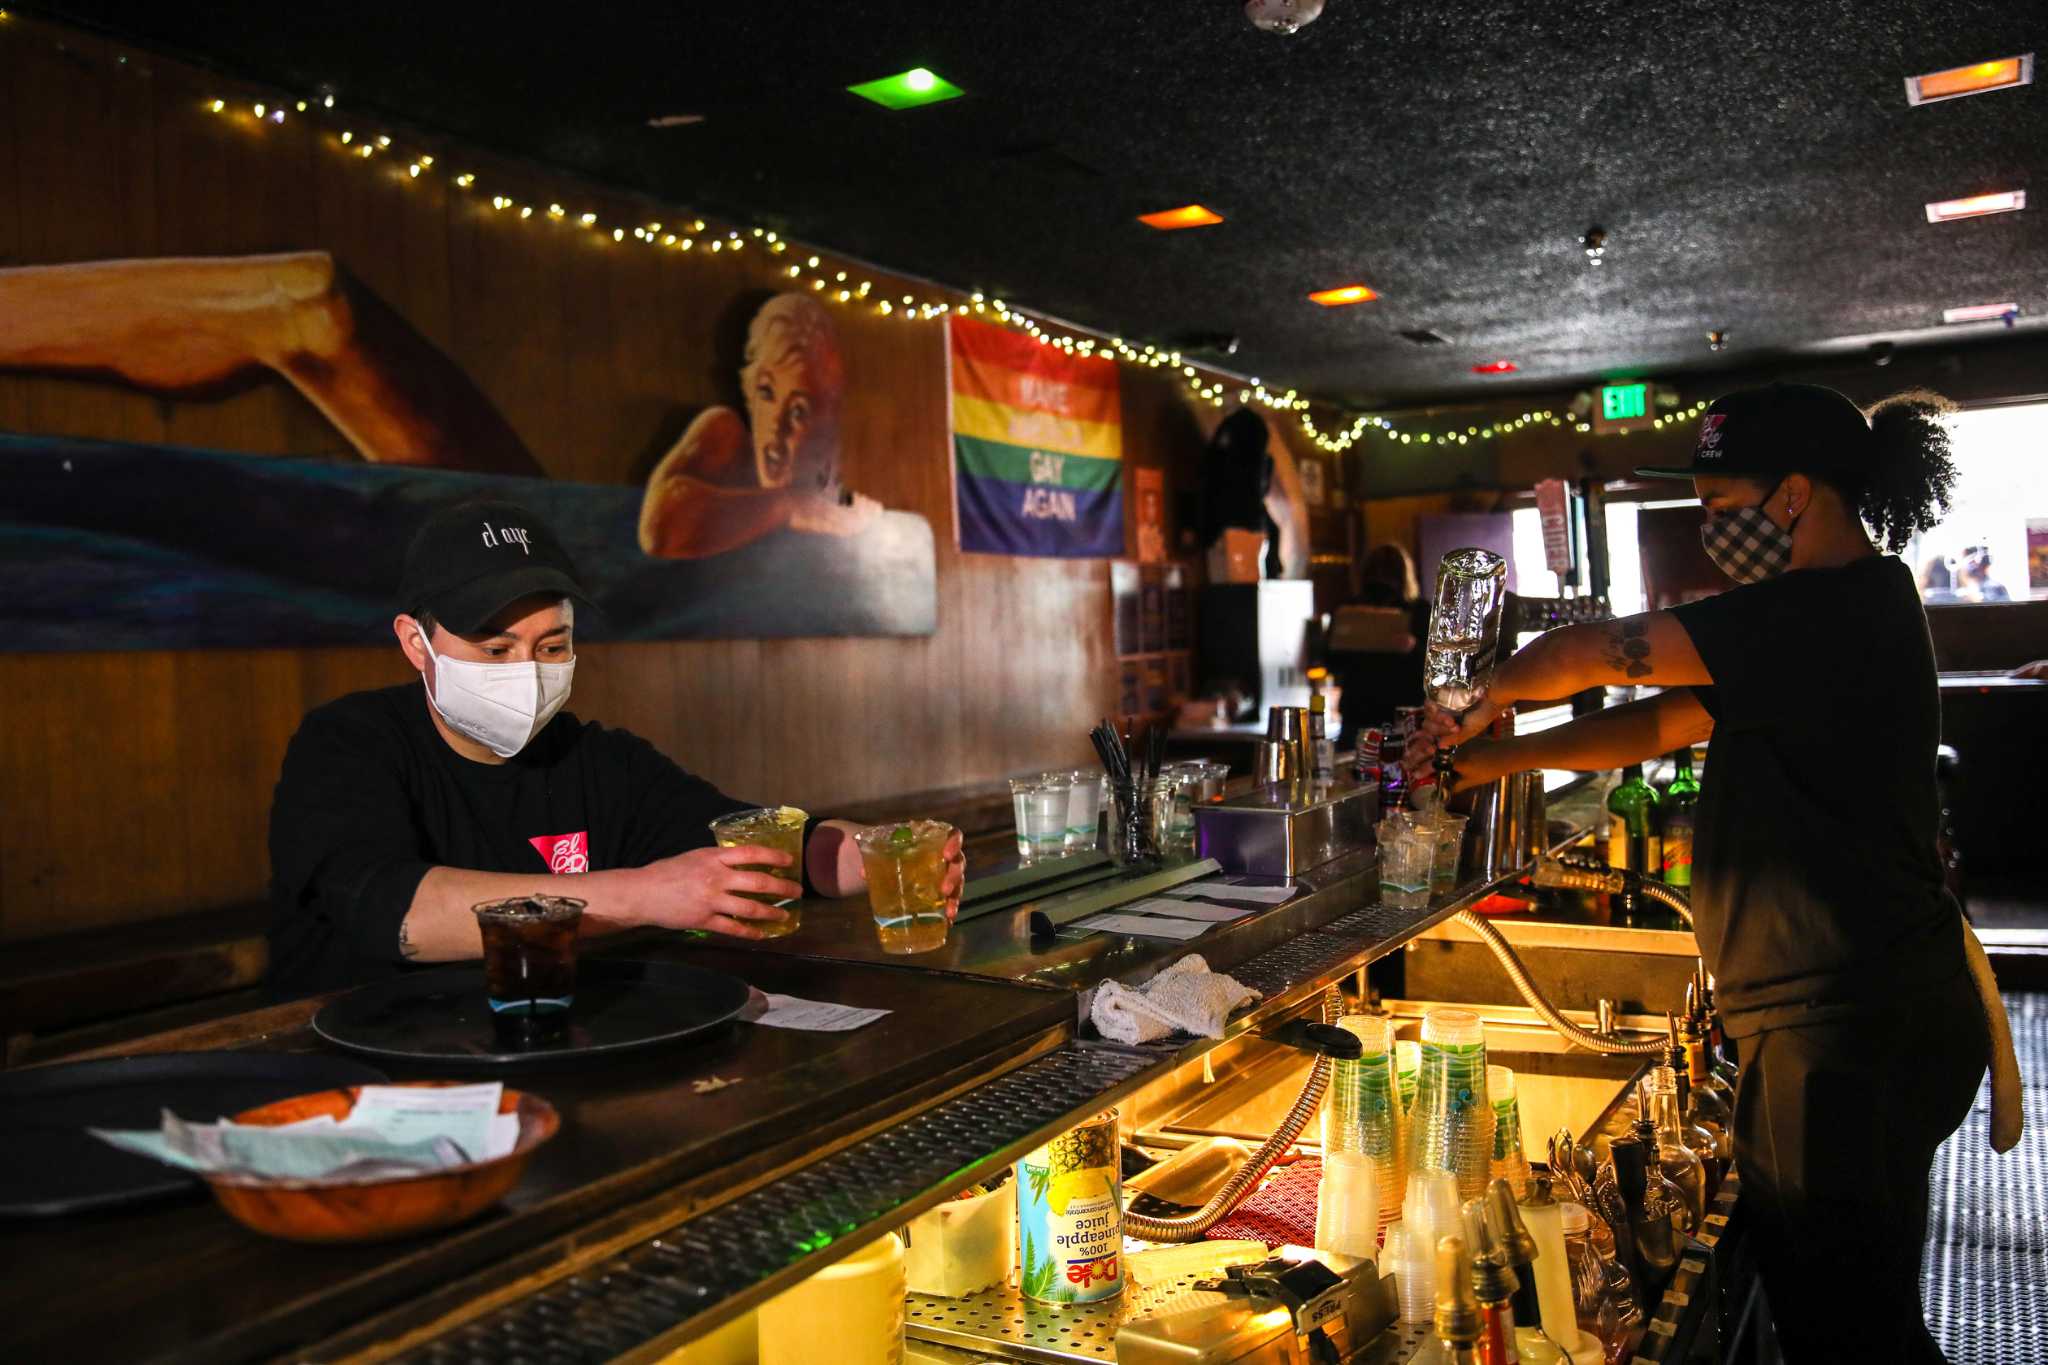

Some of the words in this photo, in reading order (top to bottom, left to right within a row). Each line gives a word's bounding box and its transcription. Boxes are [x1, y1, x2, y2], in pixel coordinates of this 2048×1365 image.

[1603, 387, 1645, 419] EXIT
[1029, 450, 1066, 485] GAY
[1021, 487, 1077, 521] AGAIN
[1056, 1221, 1121, 1248] pineapple
[1075, 1212, 1110, 1230] juice
[1079, 1243, 1108, 1257] 100%
[1067, 1258, 1118, 1289] Dole
[1312, 1299, 1341, 1323] PRESS
